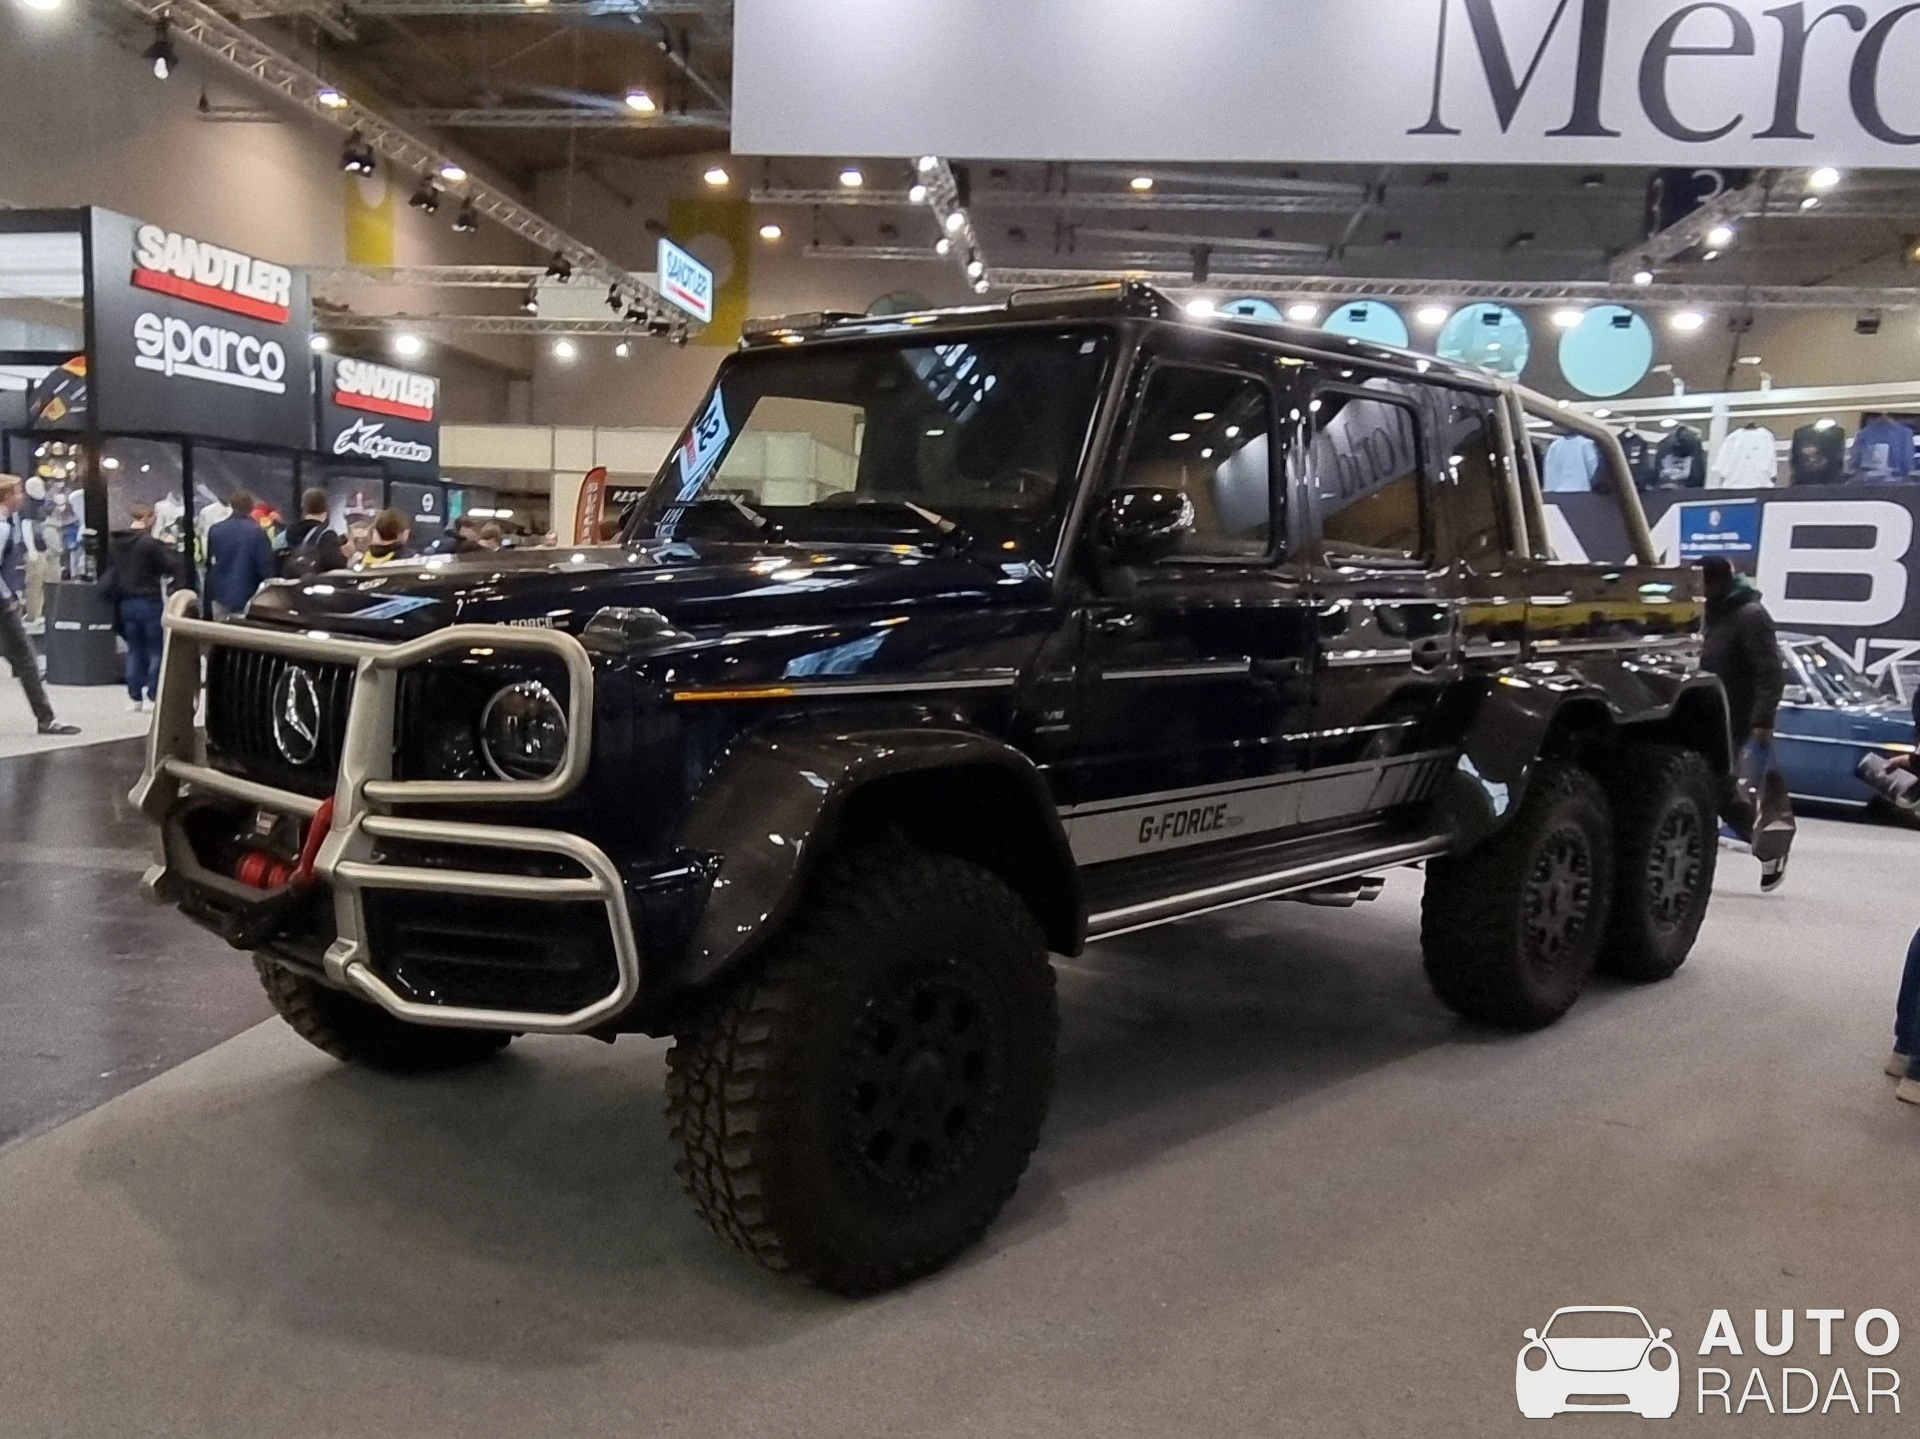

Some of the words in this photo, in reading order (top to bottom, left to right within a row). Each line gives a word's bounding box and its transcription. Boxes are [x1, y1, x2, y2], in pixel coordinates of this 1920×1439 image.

[1406, 0, 1920, 145] Merc
[136, 225, 292, 307] SANDTLER
[134, 312, 285, 381] sparco
[336, 358, 435, 409] SANDTLER
